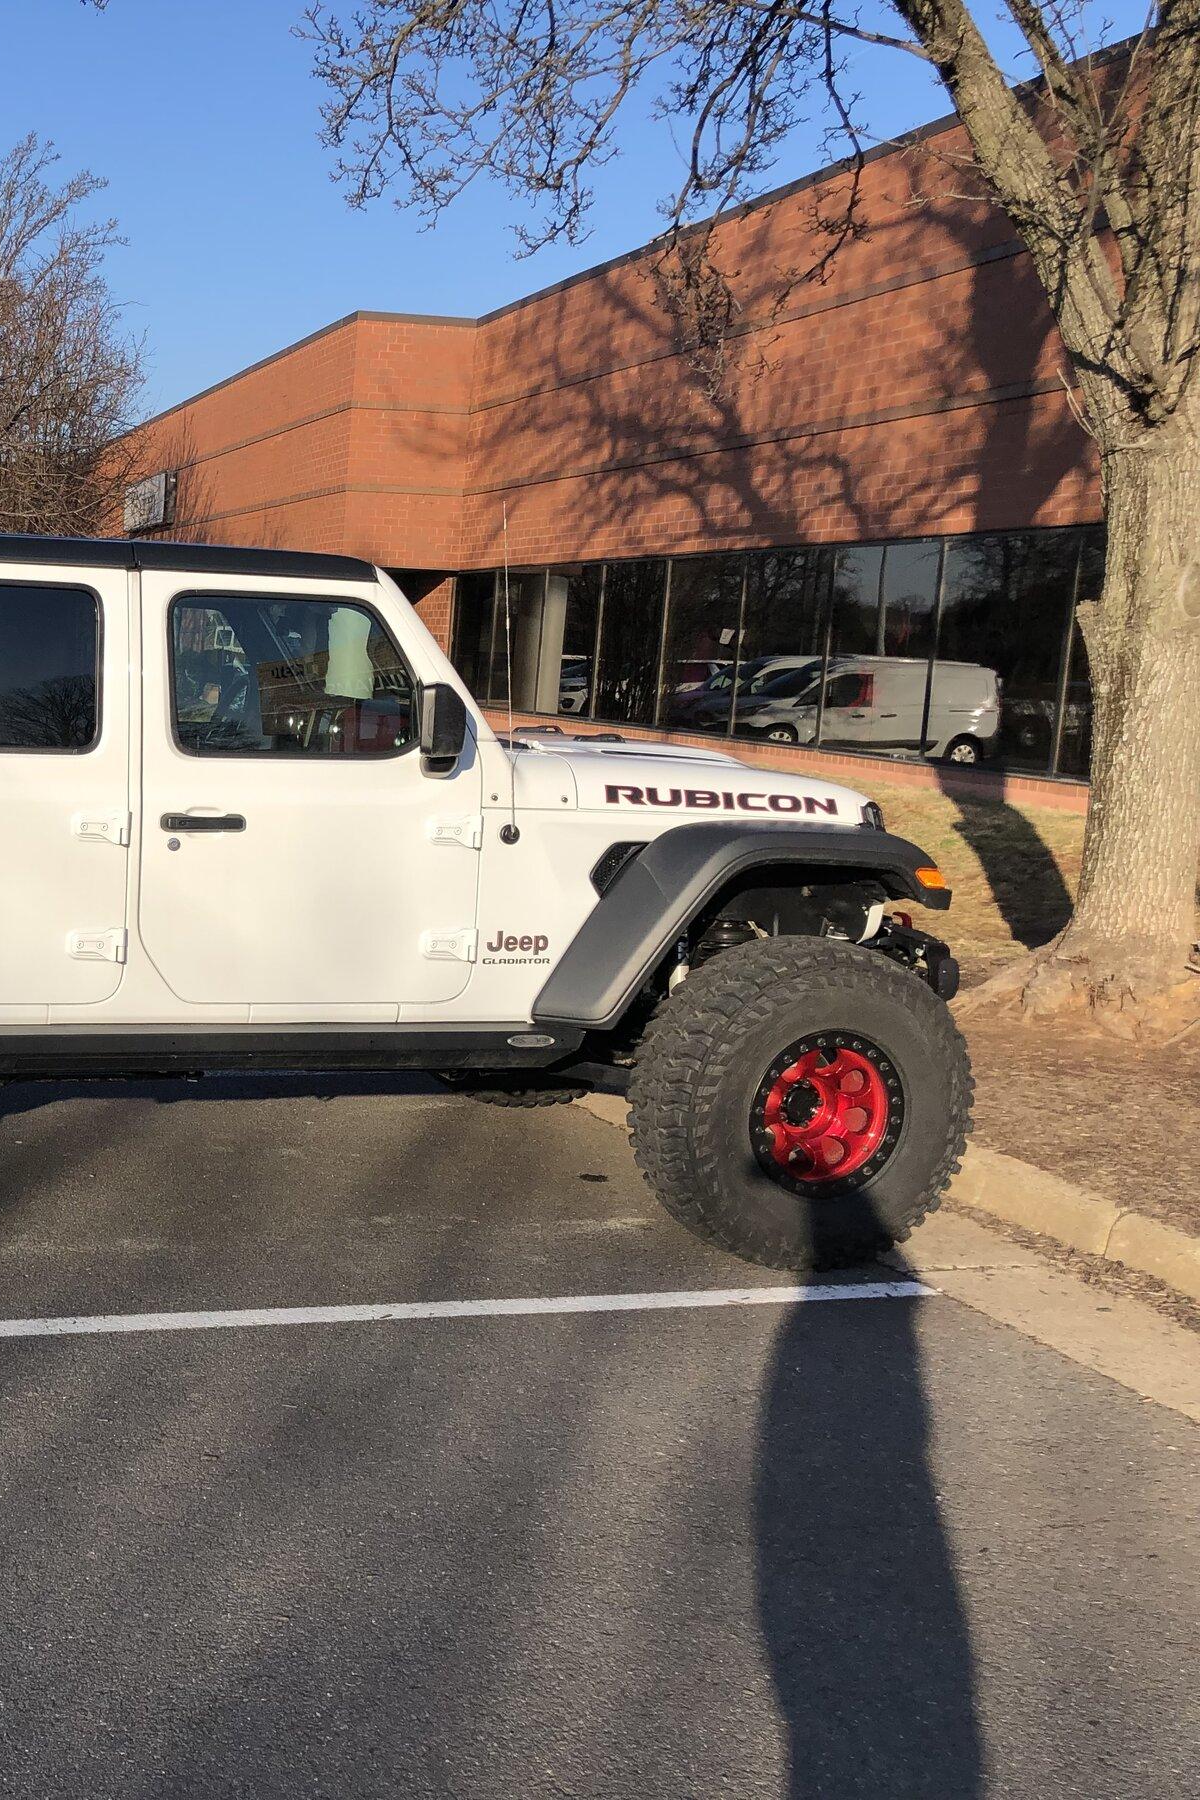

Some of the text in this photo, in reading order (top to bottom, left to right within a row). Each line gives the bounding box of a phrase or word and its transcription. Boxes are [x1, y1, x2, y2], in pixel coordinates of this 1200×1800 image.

[605, 784, 839, 816] RUBICON
[486, 930, 549, 955] Jeep
[482, 957, 551, 965] GLADIATOR
